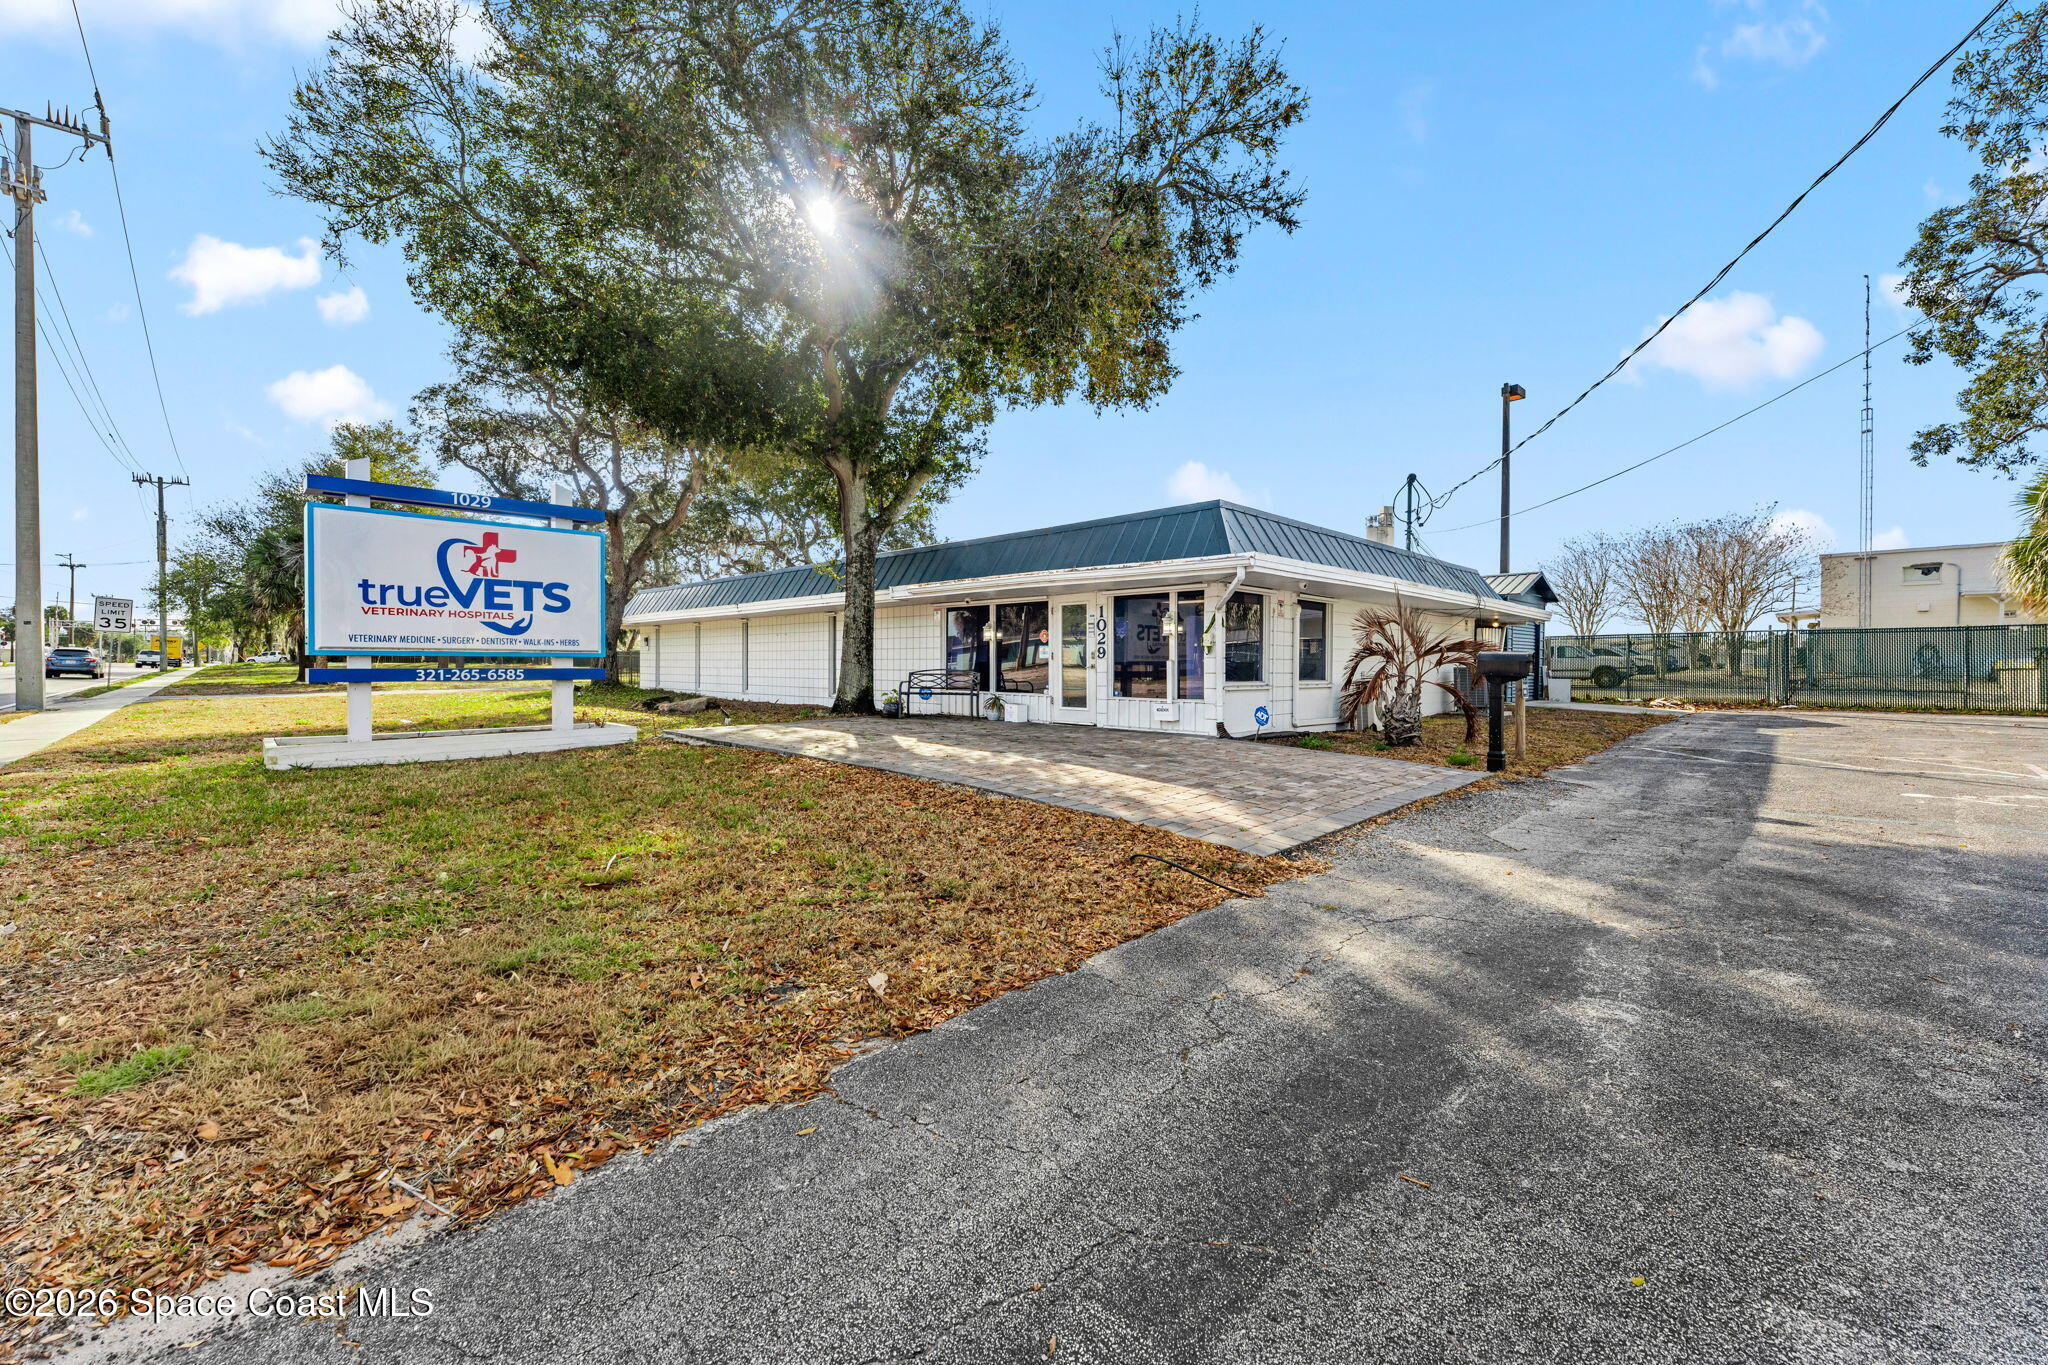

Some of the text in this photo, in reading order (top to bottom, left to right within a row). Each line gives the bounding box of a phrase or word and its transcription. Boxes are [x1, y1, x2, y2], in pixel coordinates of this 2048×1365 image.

[451, 492, 492, 508] 1029
[357, 578, 571, 613] trueVETS
[361, 606, 515, 621] VETERINARY HOSPITALS
[99, 617, 127, 629] 35
[1096, 605, 1107, 659] 1029
[348, 633, 580, 647] VETERINARY MEDICINE SURGERY DENTISTRY WALK-INS HERBS
[415, 669, 525, 682] 321-265-6585
